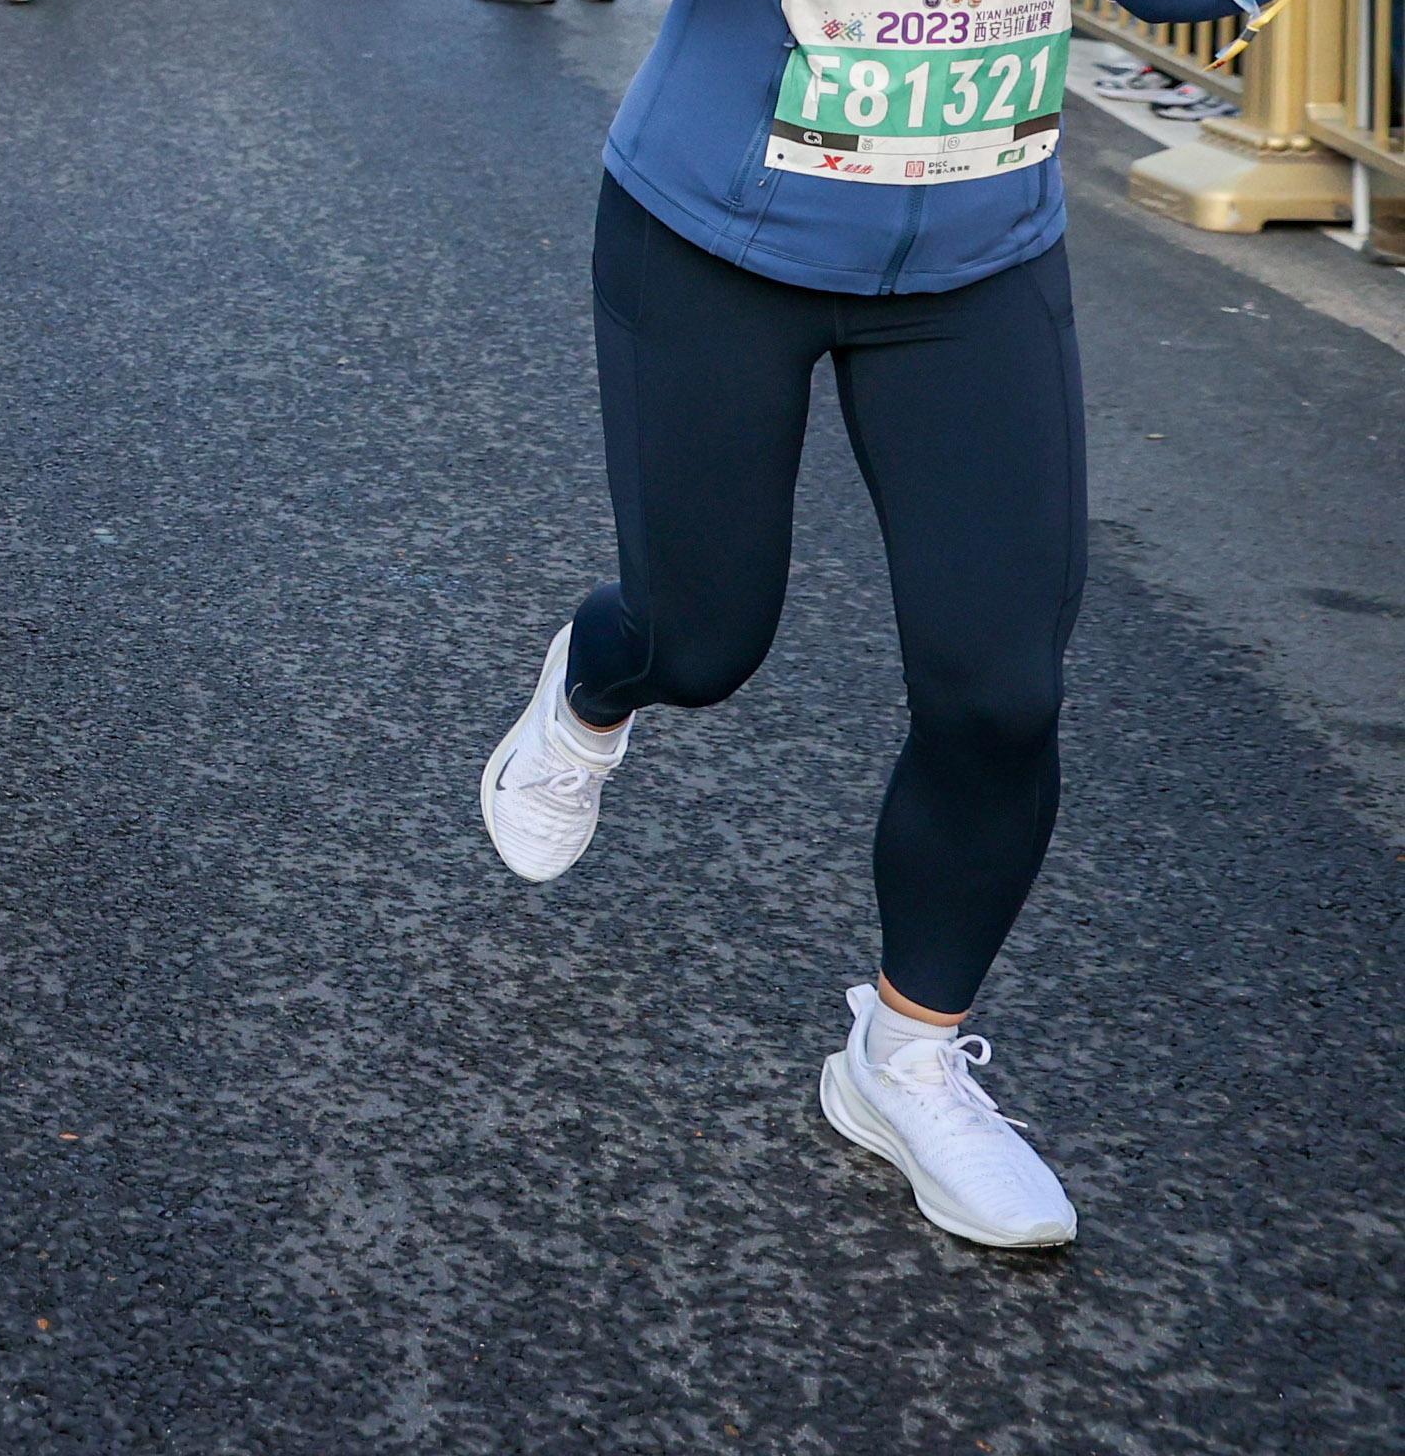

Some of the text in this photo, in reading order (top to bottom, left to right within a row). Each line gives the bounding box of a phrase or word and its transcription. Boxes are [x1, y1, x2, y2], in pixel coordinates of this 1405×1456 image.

[875, 0, 1056, 45] 2023 XI'AN MARATHON
[974, 12, 1053, 42] 西安马拉松赛
[800, 45, 1051, 129] F81321
